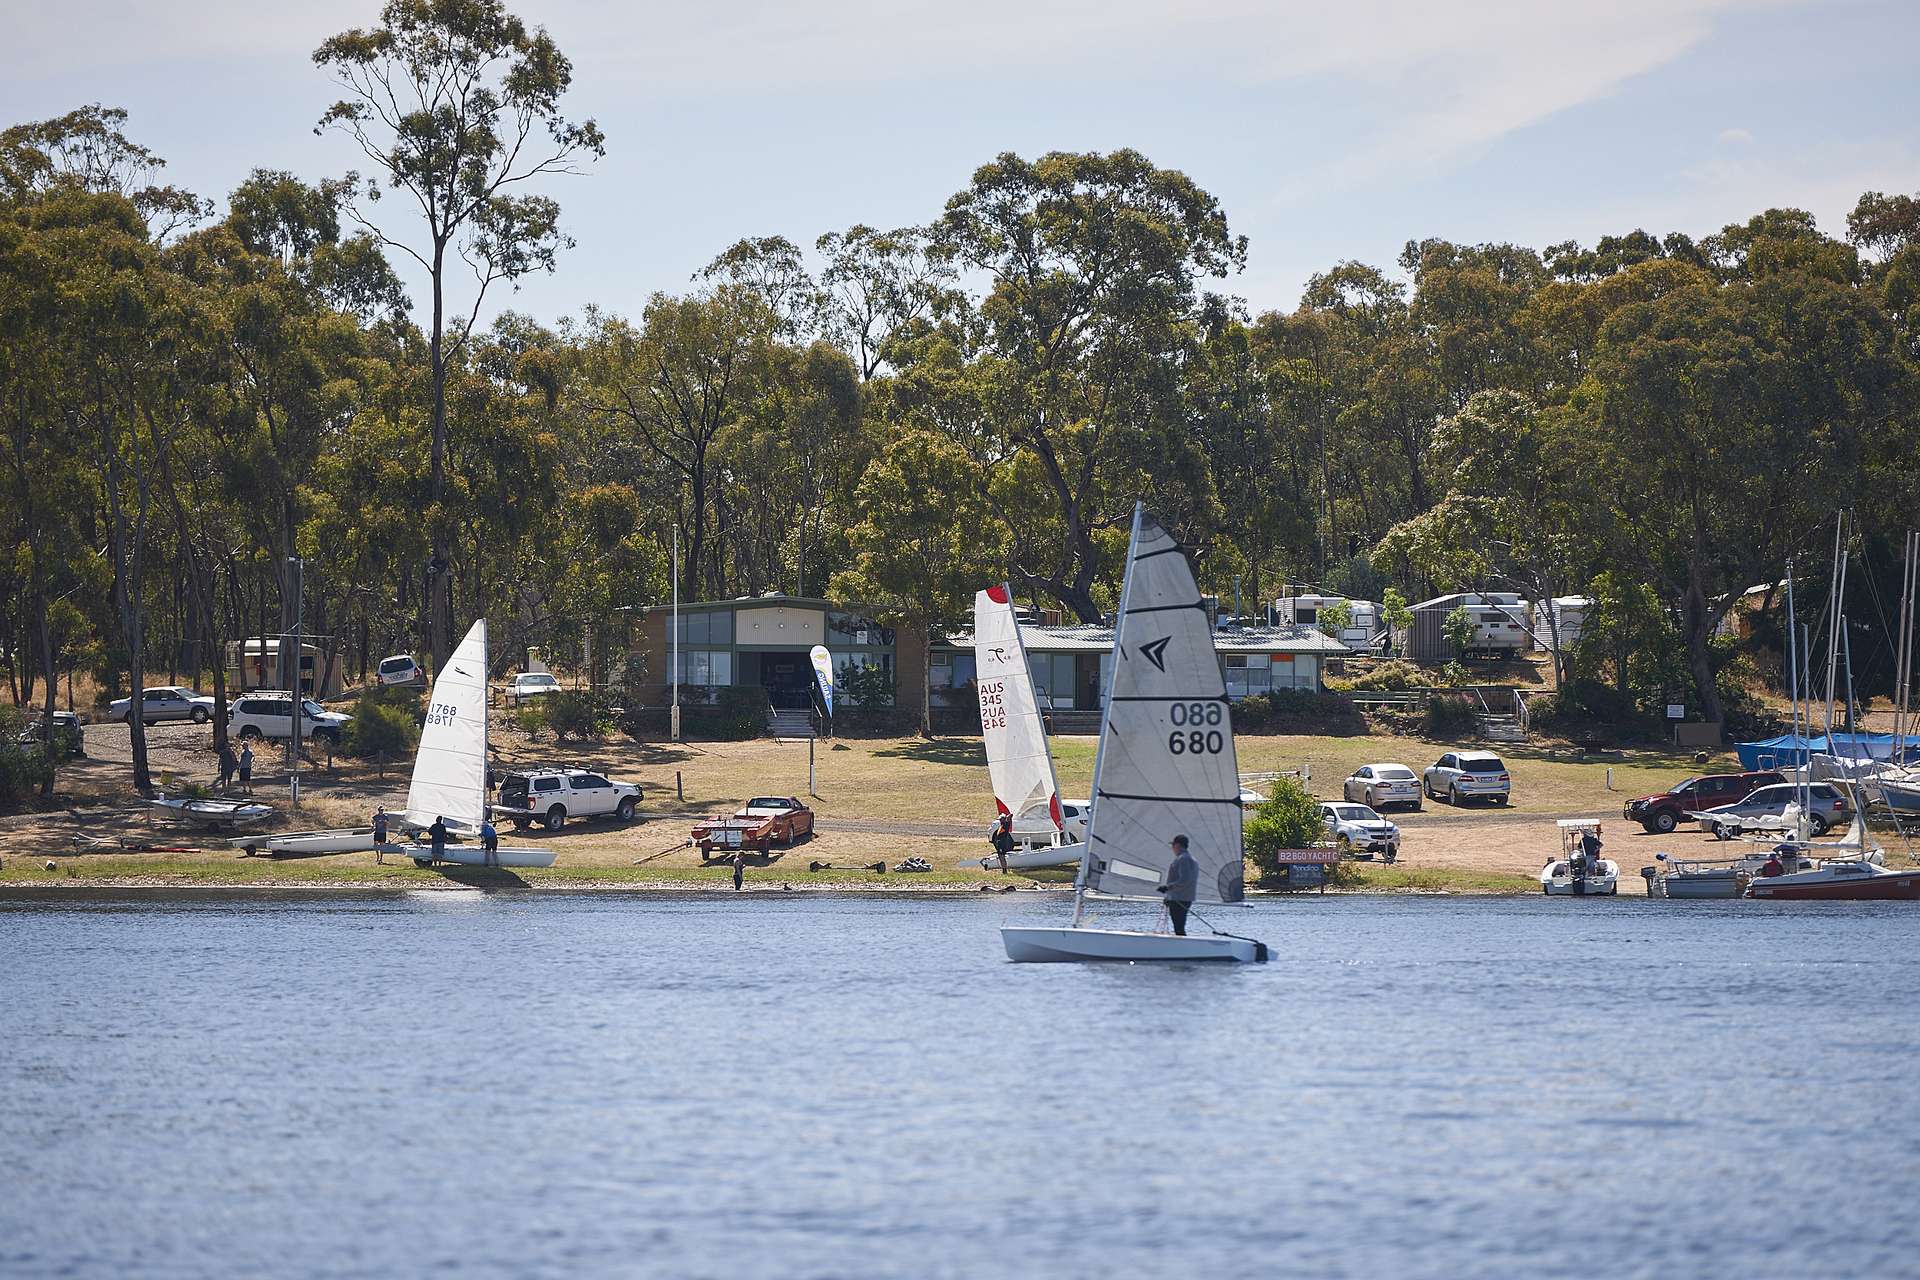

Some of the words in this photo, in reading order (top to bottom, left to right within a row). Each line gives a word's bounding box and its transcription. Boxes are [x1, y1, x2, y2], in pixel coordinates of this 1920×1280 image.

[981, 682, 1004, 695] AUS
[981, 694, 1002, 706] 345
[431, 703, 457, 716] 1768
[1169, 730, 1223, 755] 680
[1307, 852, 1331, 860] YACHT
